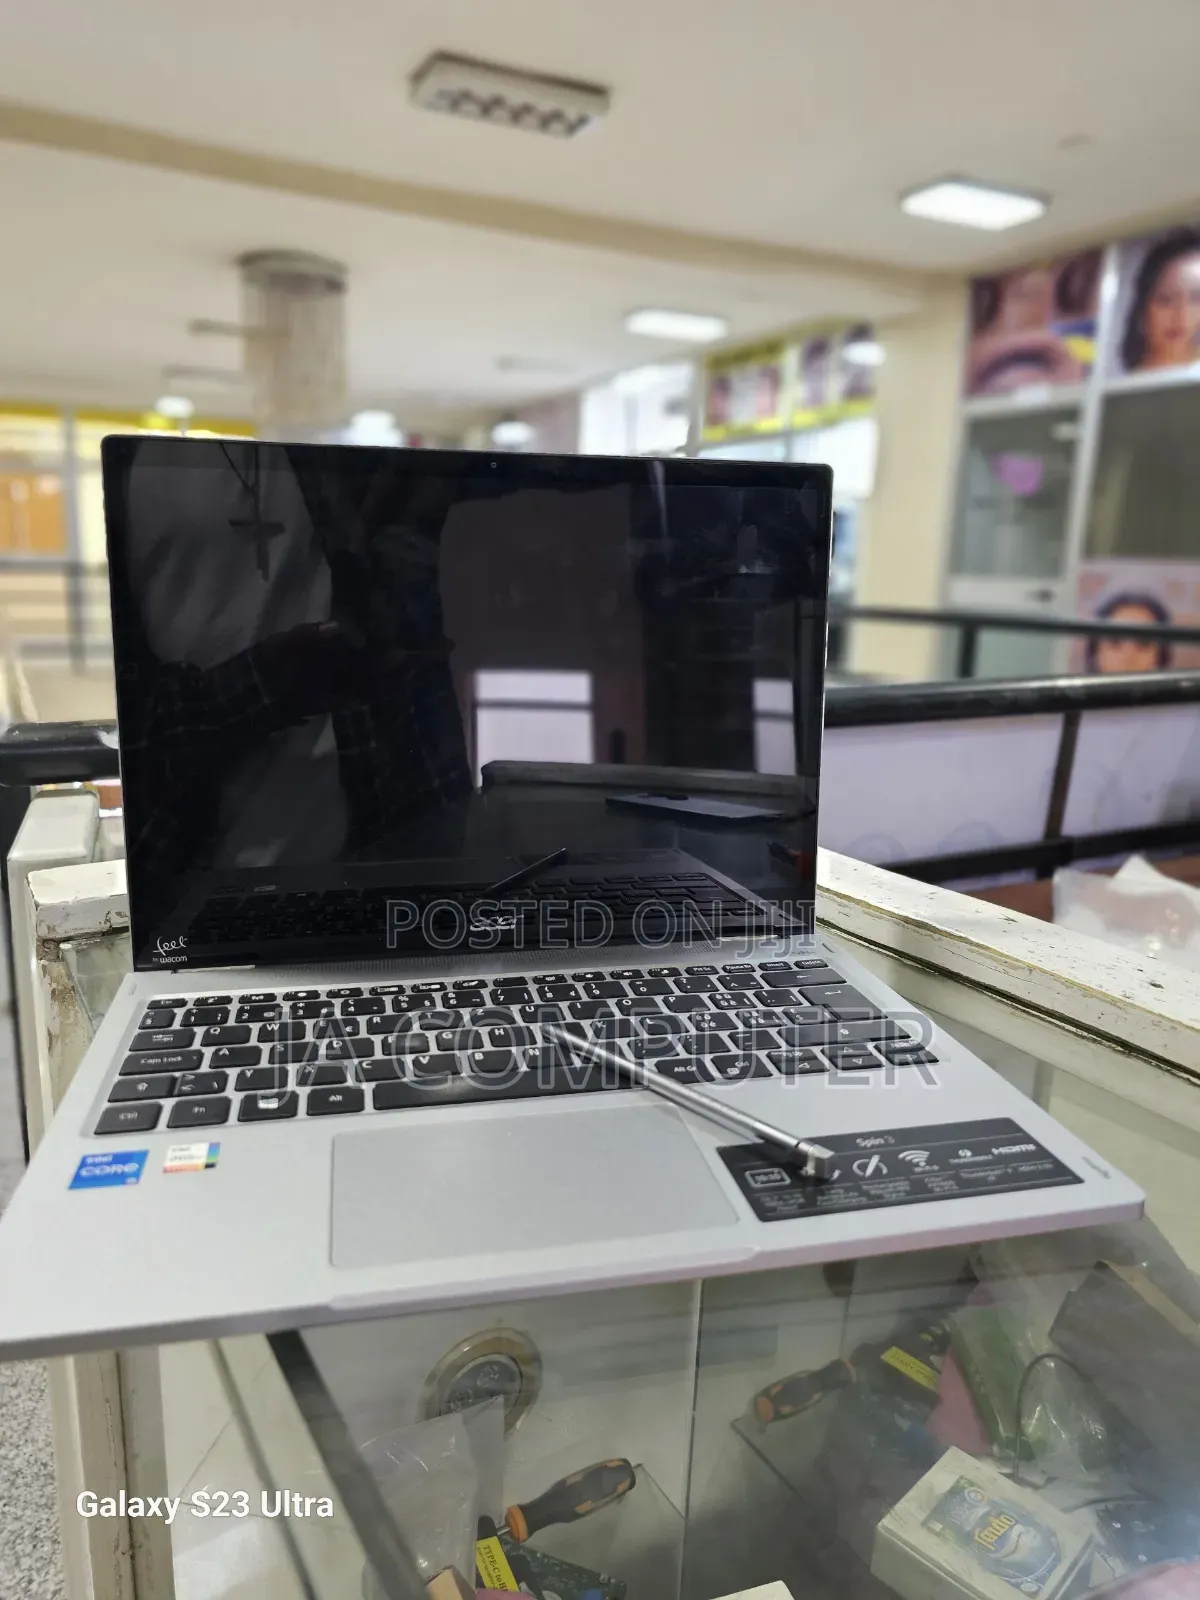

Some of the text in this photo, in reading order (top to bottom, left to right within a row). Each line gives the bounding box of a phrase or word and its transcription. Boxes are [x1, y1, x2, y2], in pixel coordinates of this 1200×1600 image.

[470, 915, 524, 931] acer
[160, 955, 188, 963] wacom
[210, 1027, 221, 1035] Q
[266, 1023, 280, 1031] W
[441, 1031, 453, 1039] G
[218, 1048, 230, 1056] A
[474, 1052, 484, 1060] B
[528, 1048, 539, 1056] N
[419, 1056, 430, 1064] V
[361, 1060, 373, 1069] C
[856, 1136, 885, 1149] Spin
